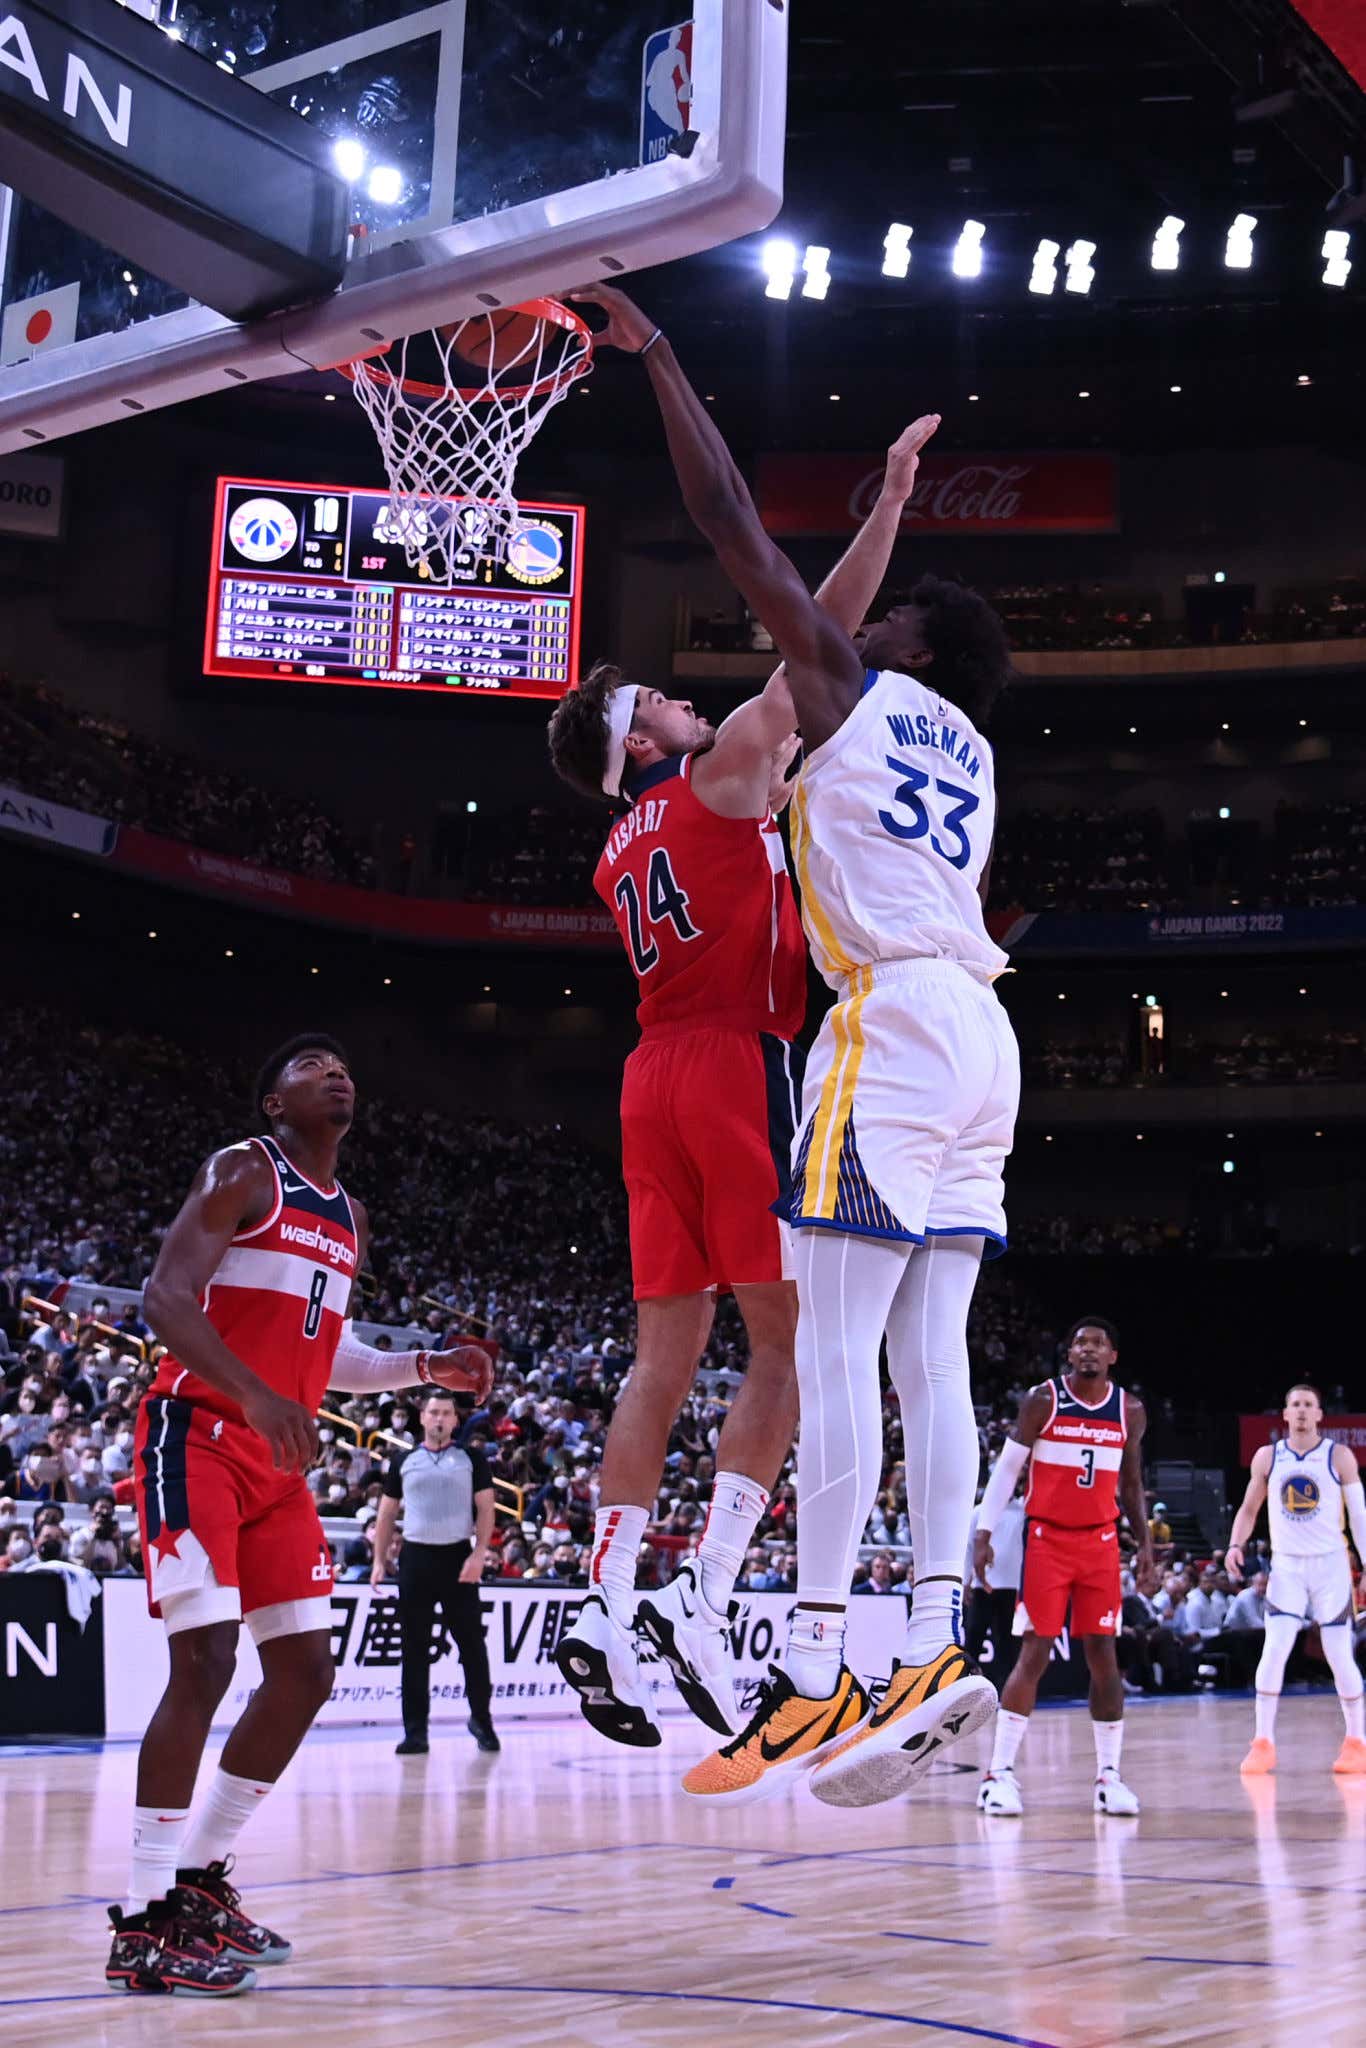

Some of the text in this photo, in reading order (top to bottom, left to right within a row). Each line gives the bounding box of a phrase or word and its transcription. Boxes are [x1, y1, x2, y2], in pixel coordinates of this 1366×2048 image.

[361, 556, 387, 570] 1ST
[886, 714, 980, 779] WISEMAN
[604, 799, 669, 867] KISPERT
[878, 754, 980, 871] 33
[614, 847, 704, 977] 24
[1161, 913, 1284, 935] JAPAN GAMES 2022
[280, 1223, 356, 1267] washington
[303, 1269, 328, 1340] 8
[1053, 1422, 1122, 1444] washington
[1076, 1447, 1096, 1489] 3
